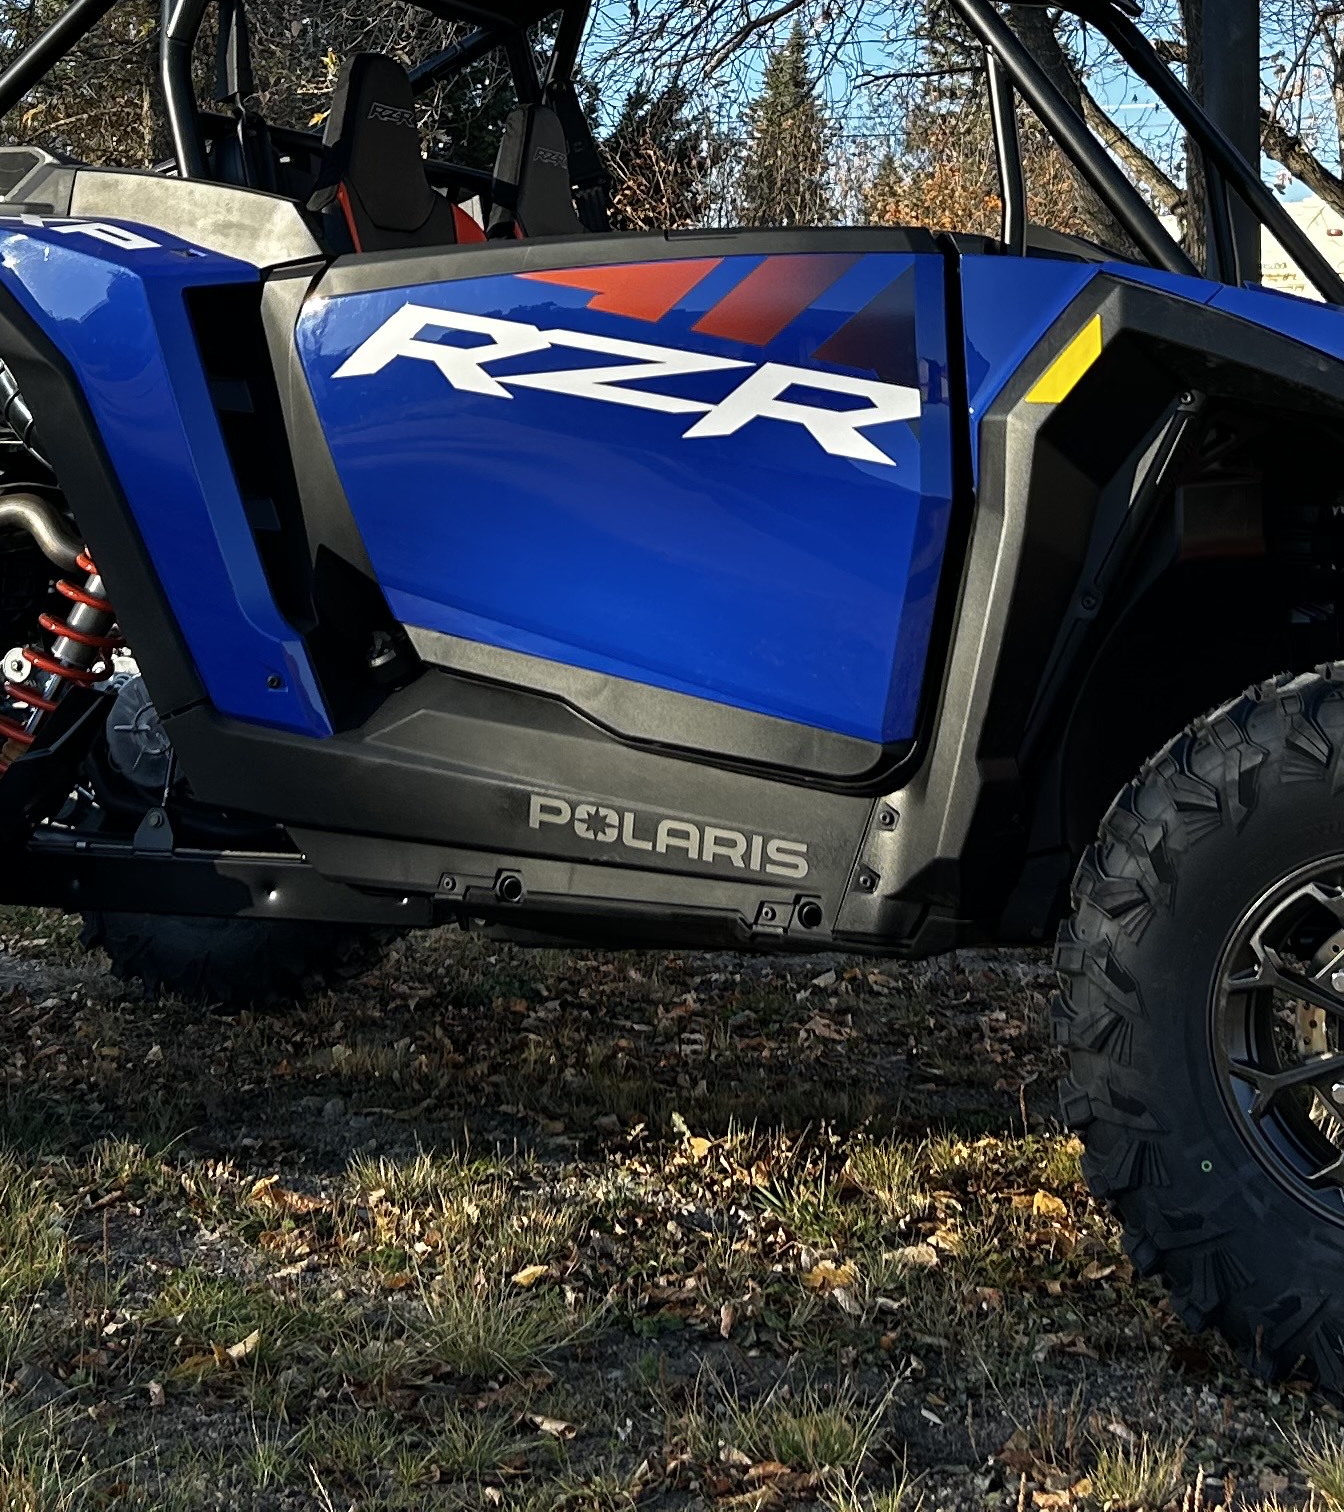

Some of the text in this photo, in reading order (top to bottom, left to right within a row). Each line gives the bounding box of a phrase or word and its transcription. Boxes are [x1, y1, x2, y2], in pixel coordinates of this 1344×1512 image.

[367, 101, 416, 128] RZR
[330, 301, 922, 467] RZR
[529, 793, 810, 879] POLARIS
